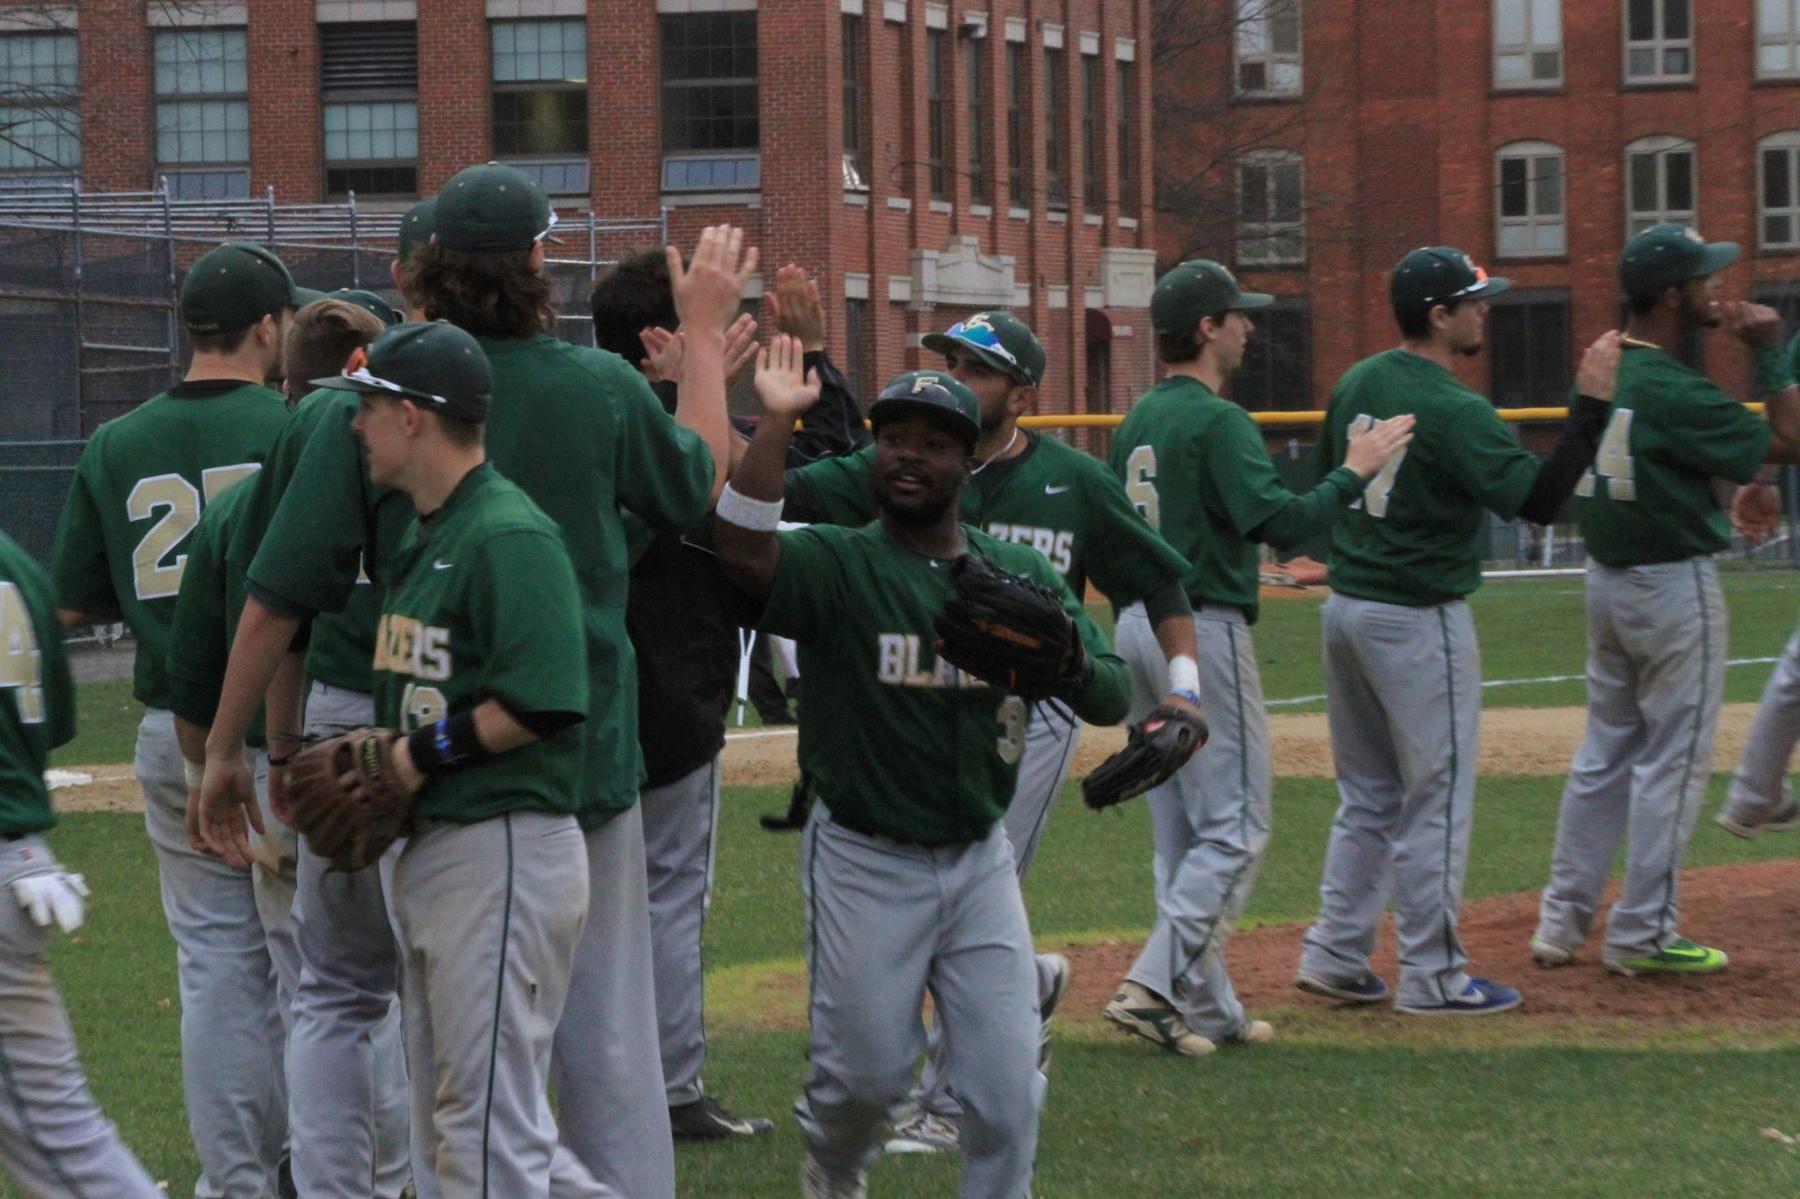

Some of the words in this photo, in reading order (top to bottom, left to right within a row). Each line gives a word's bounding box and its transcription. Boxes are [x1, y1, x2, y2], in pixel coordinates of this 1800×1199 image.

[1125, 445, 1161, 532] 6
[1574, 407, 1638, 501] 4
[0, 580, 46, 724] 4
[996, 695, 1026, 765] 3
